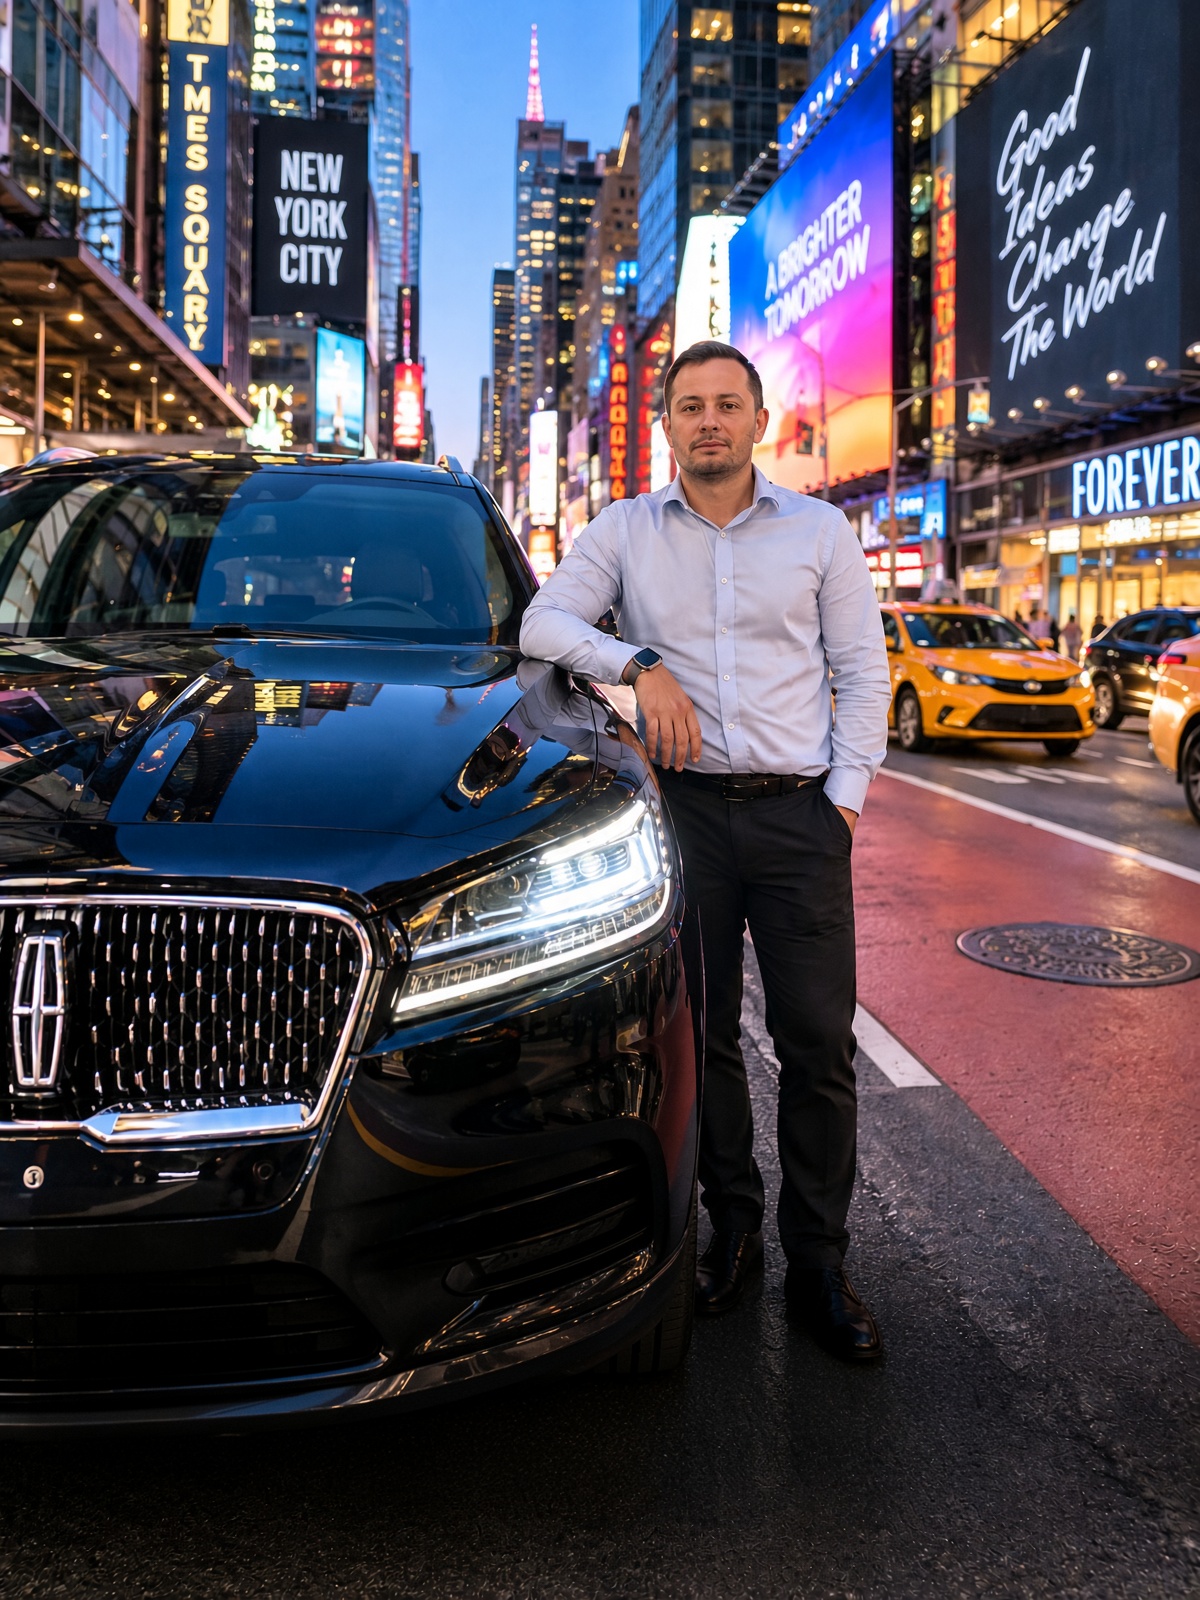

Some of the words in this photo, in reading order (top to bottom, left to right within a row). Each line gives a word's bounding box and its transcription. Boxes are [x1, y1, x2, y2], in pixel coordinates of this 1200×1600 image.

[184, 54, 211, 171] TMES
[280, 149, 344, 194] NEW
[996, 46, 1091, 197] Good
[274, 196, 348, 240] YORK
[765, 261, 778, 301] A
[778, 179, 862, 290] BRIGHTER
[998, 145, 1096, 260] Ideas
[1007, 188, 1136, 313] Change
[183, 184, 210, 351] SQUARY
[279, 242, 344, 287] CITY
[764, 223, 871, 343] TOMORROW
[1001, 302, 1057, 381] The
[1062, 212, 1168, 339] World
[1072, 436, 1200, 519] FOREVER
